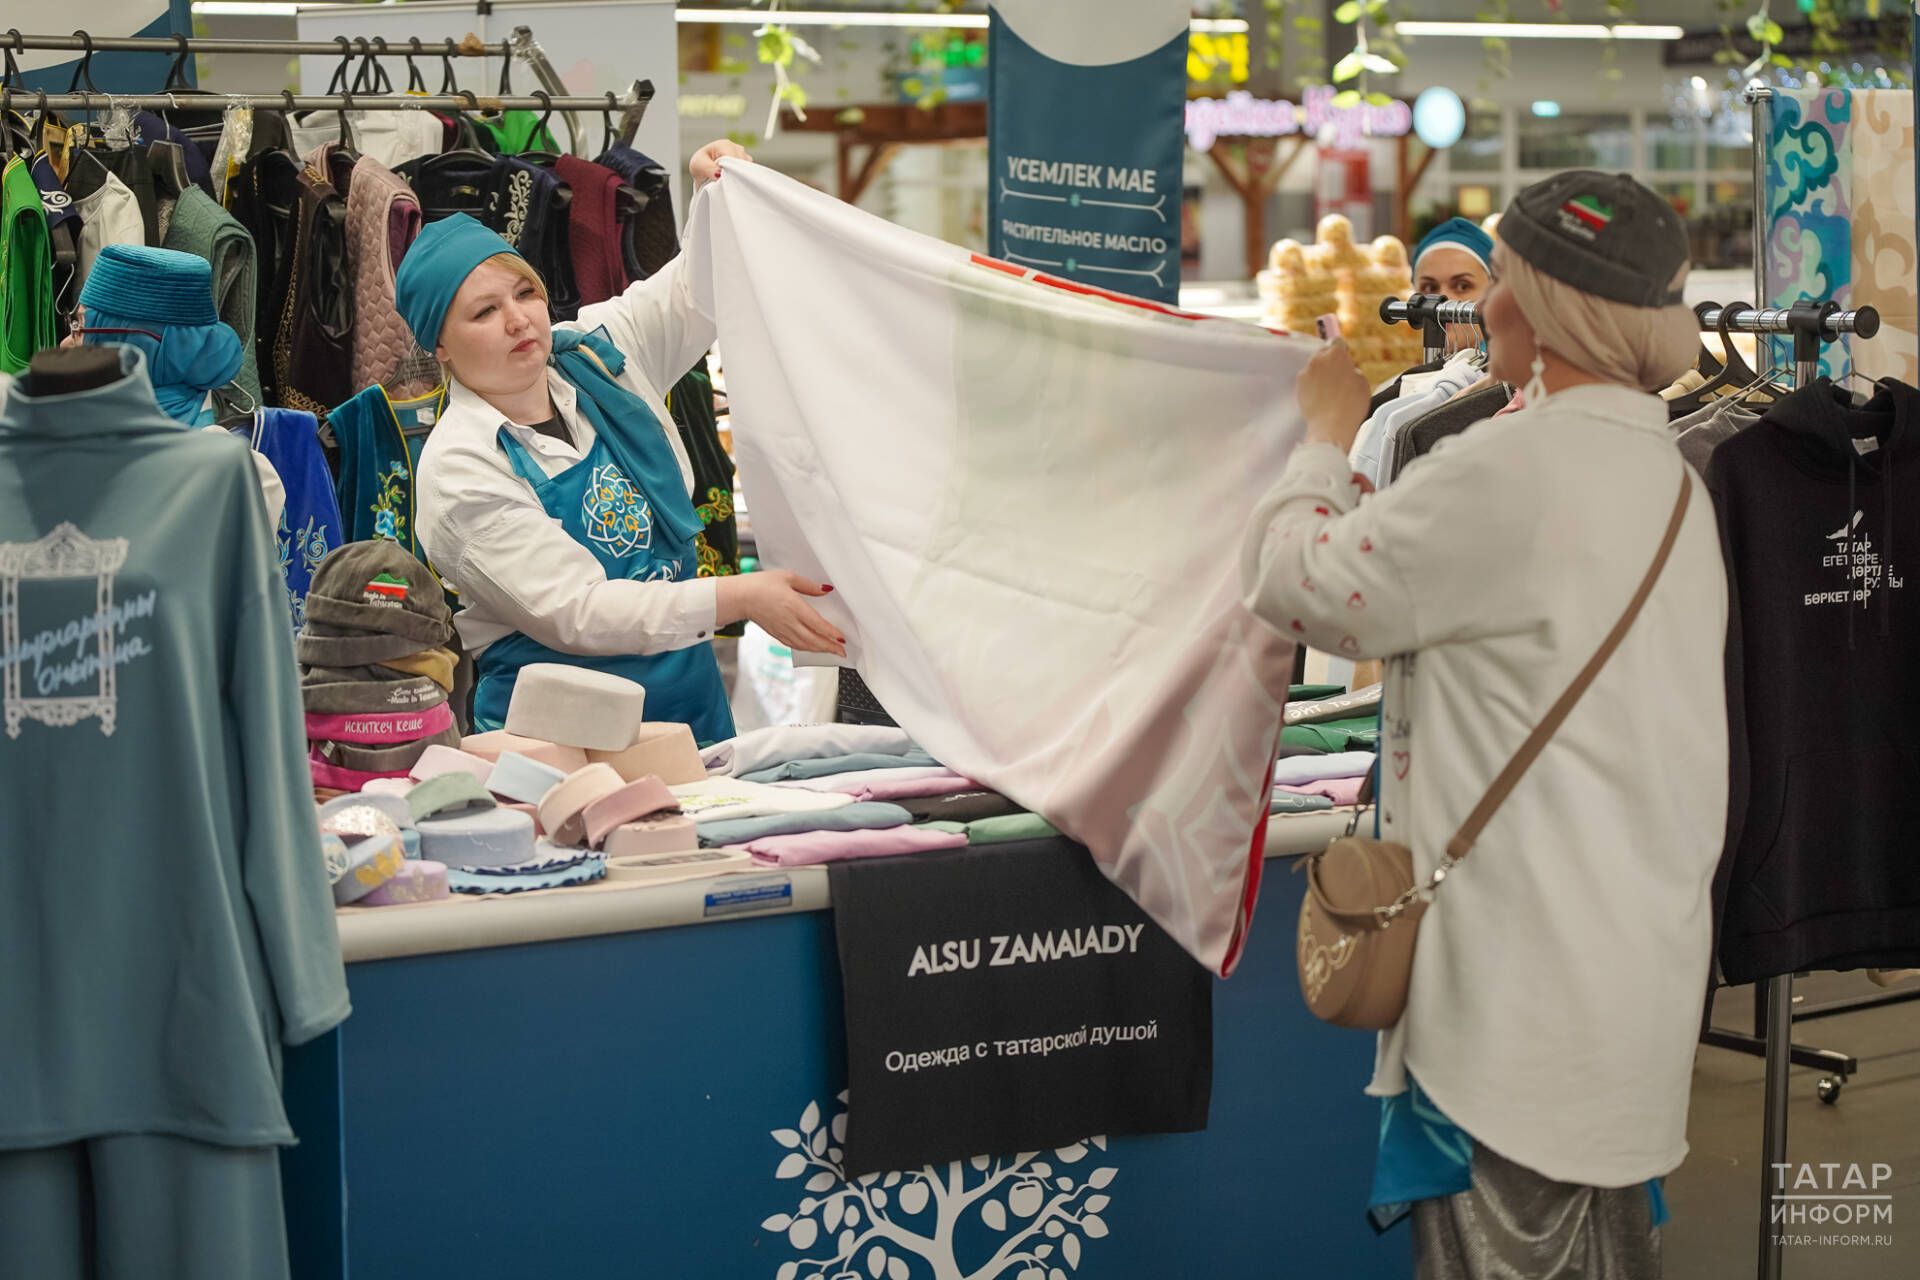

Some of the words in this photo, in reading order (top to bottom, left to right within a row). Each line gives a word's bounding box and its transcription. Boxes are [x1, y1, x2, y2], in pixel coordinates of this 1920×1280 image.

[1107, 167, 1157, 193] МАЕ
[1002, 219, 1102, 249] РАСТИТЕЛЬНОЕ
[1104, 232, 1167, 254] МАСЛО
[907, 938, 980, 977] ALSU
[885, 1045, 970, 1073] Одежда
[975, 1042, 988, 1057] с
[993, 1025, 1087, 1057] татарской
[1090, 1020, 1158, 1045] душой
